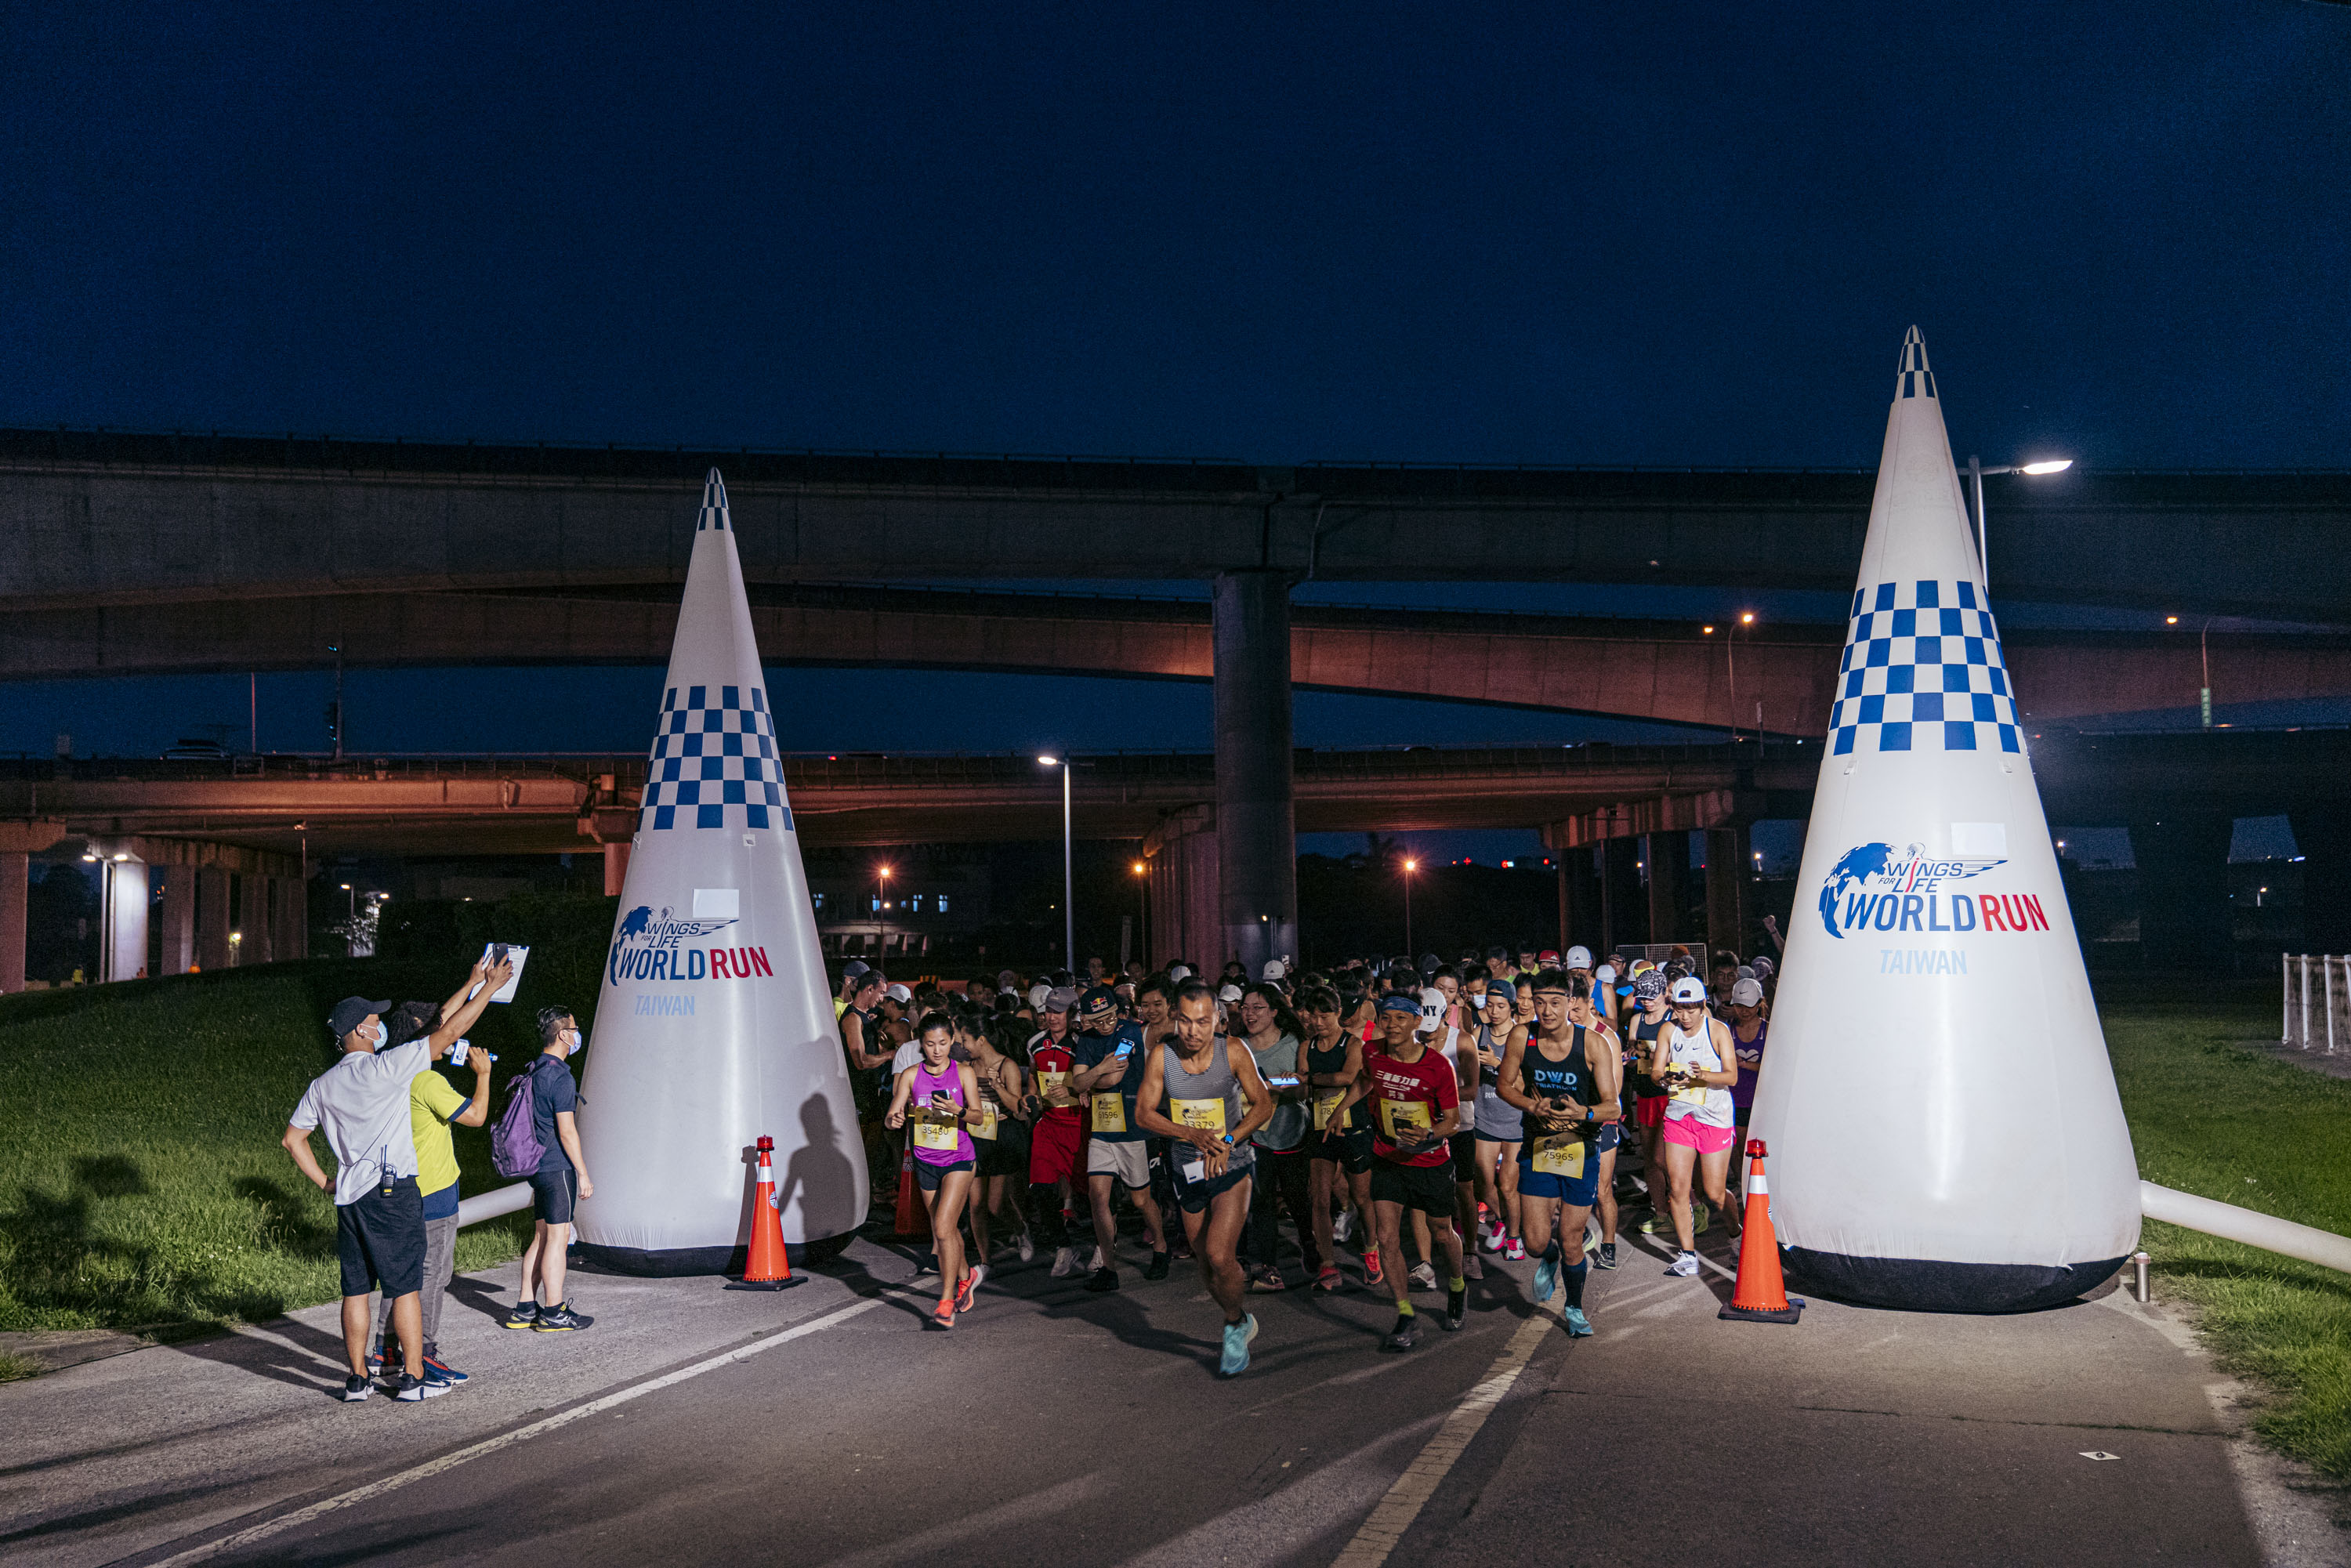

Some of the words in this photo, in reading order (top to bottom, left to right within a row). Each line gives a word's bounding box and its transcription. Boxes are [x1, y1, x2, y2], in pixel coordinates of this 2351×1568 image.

[1888, 859, 1964, 877] WINGS
[1892, 878, 1942, 893] LIFE
[1844, 893, 1976, 932] WORLD
[1978, 894, 2050, 932] RUN
[647, 921, 701, 935] WINGS
[648, 936, 683, 948] LIFE
[618, 948, 706, 980] WORLD
[709, 947, 773, 980] RUN
[1881, 949, 1968, 975] TAIWAN
[635, 995, 695, 1016] TAIWAN
[1422, 1005, 1436, 1016] NY
[1534, 1070, 1577, 1085] DWD
[1544, 1151, 1574, 1161] 75965
